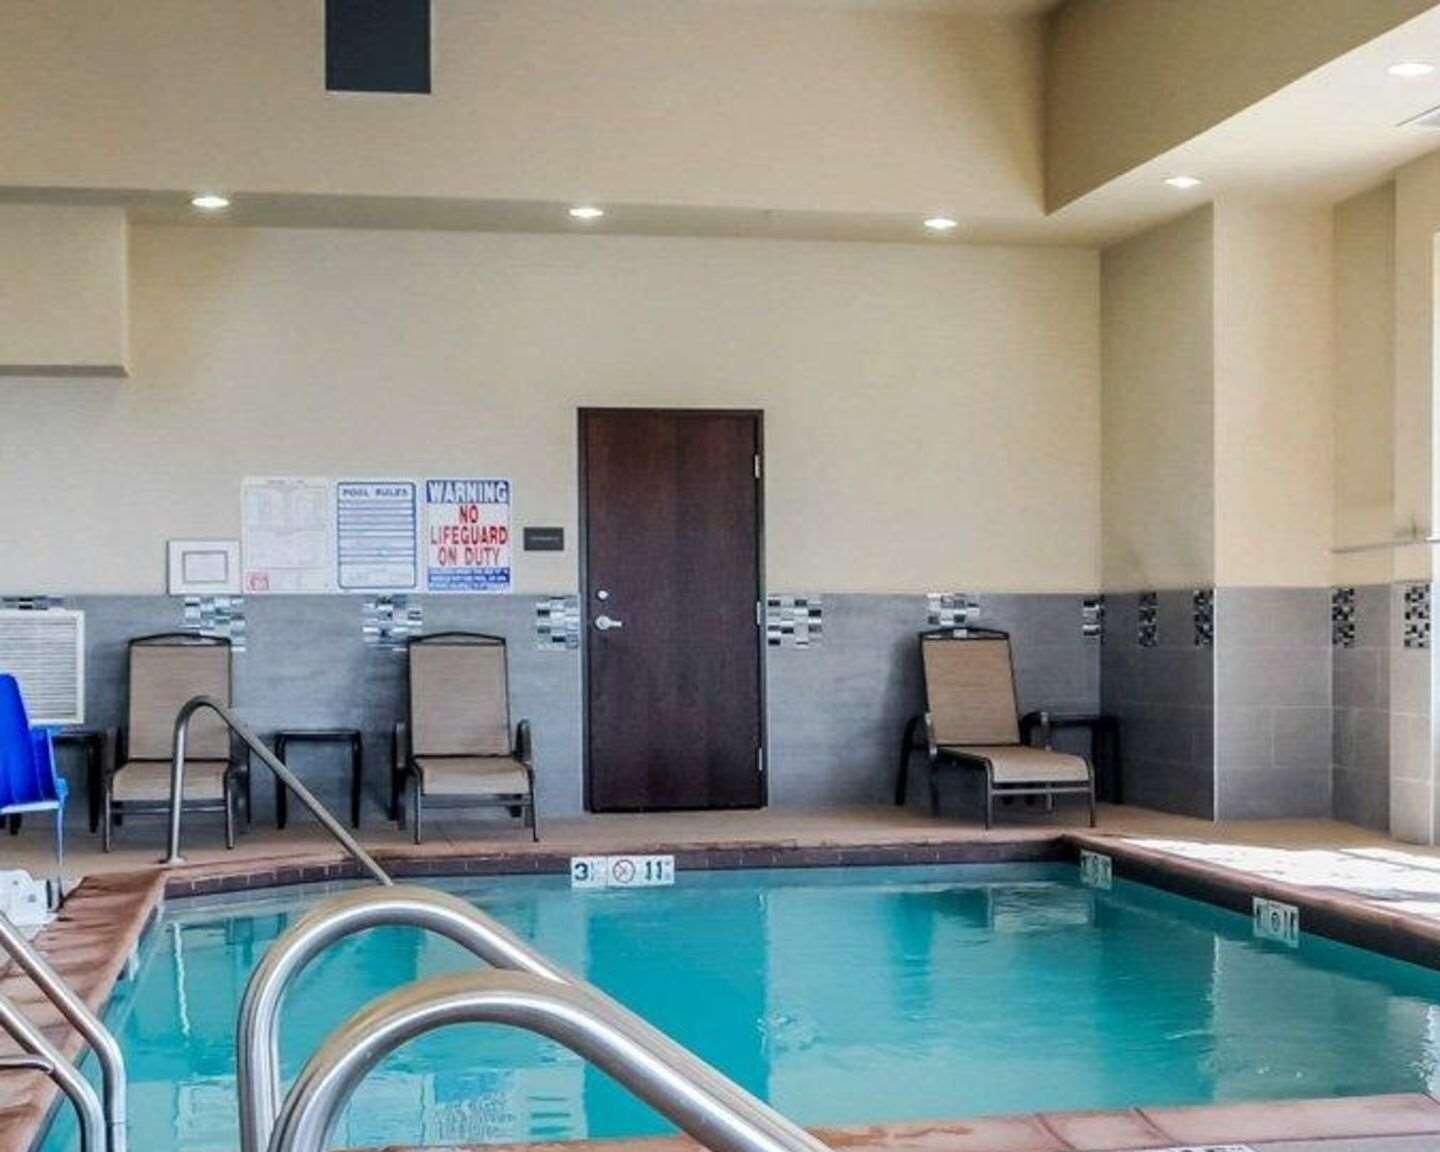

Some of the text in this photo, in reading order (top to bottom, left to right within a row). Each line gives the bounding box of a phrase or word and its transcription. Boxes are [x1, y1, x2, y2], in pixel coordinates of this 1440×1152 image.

[428, 481, 507, 502] WARNING
[459, 504, 479, 523] NO
[430, 526, 508, 545] LIFEGUARD
[438, 547, 500, 566] ON DUTY
[574, 862, 589, 881] 3
